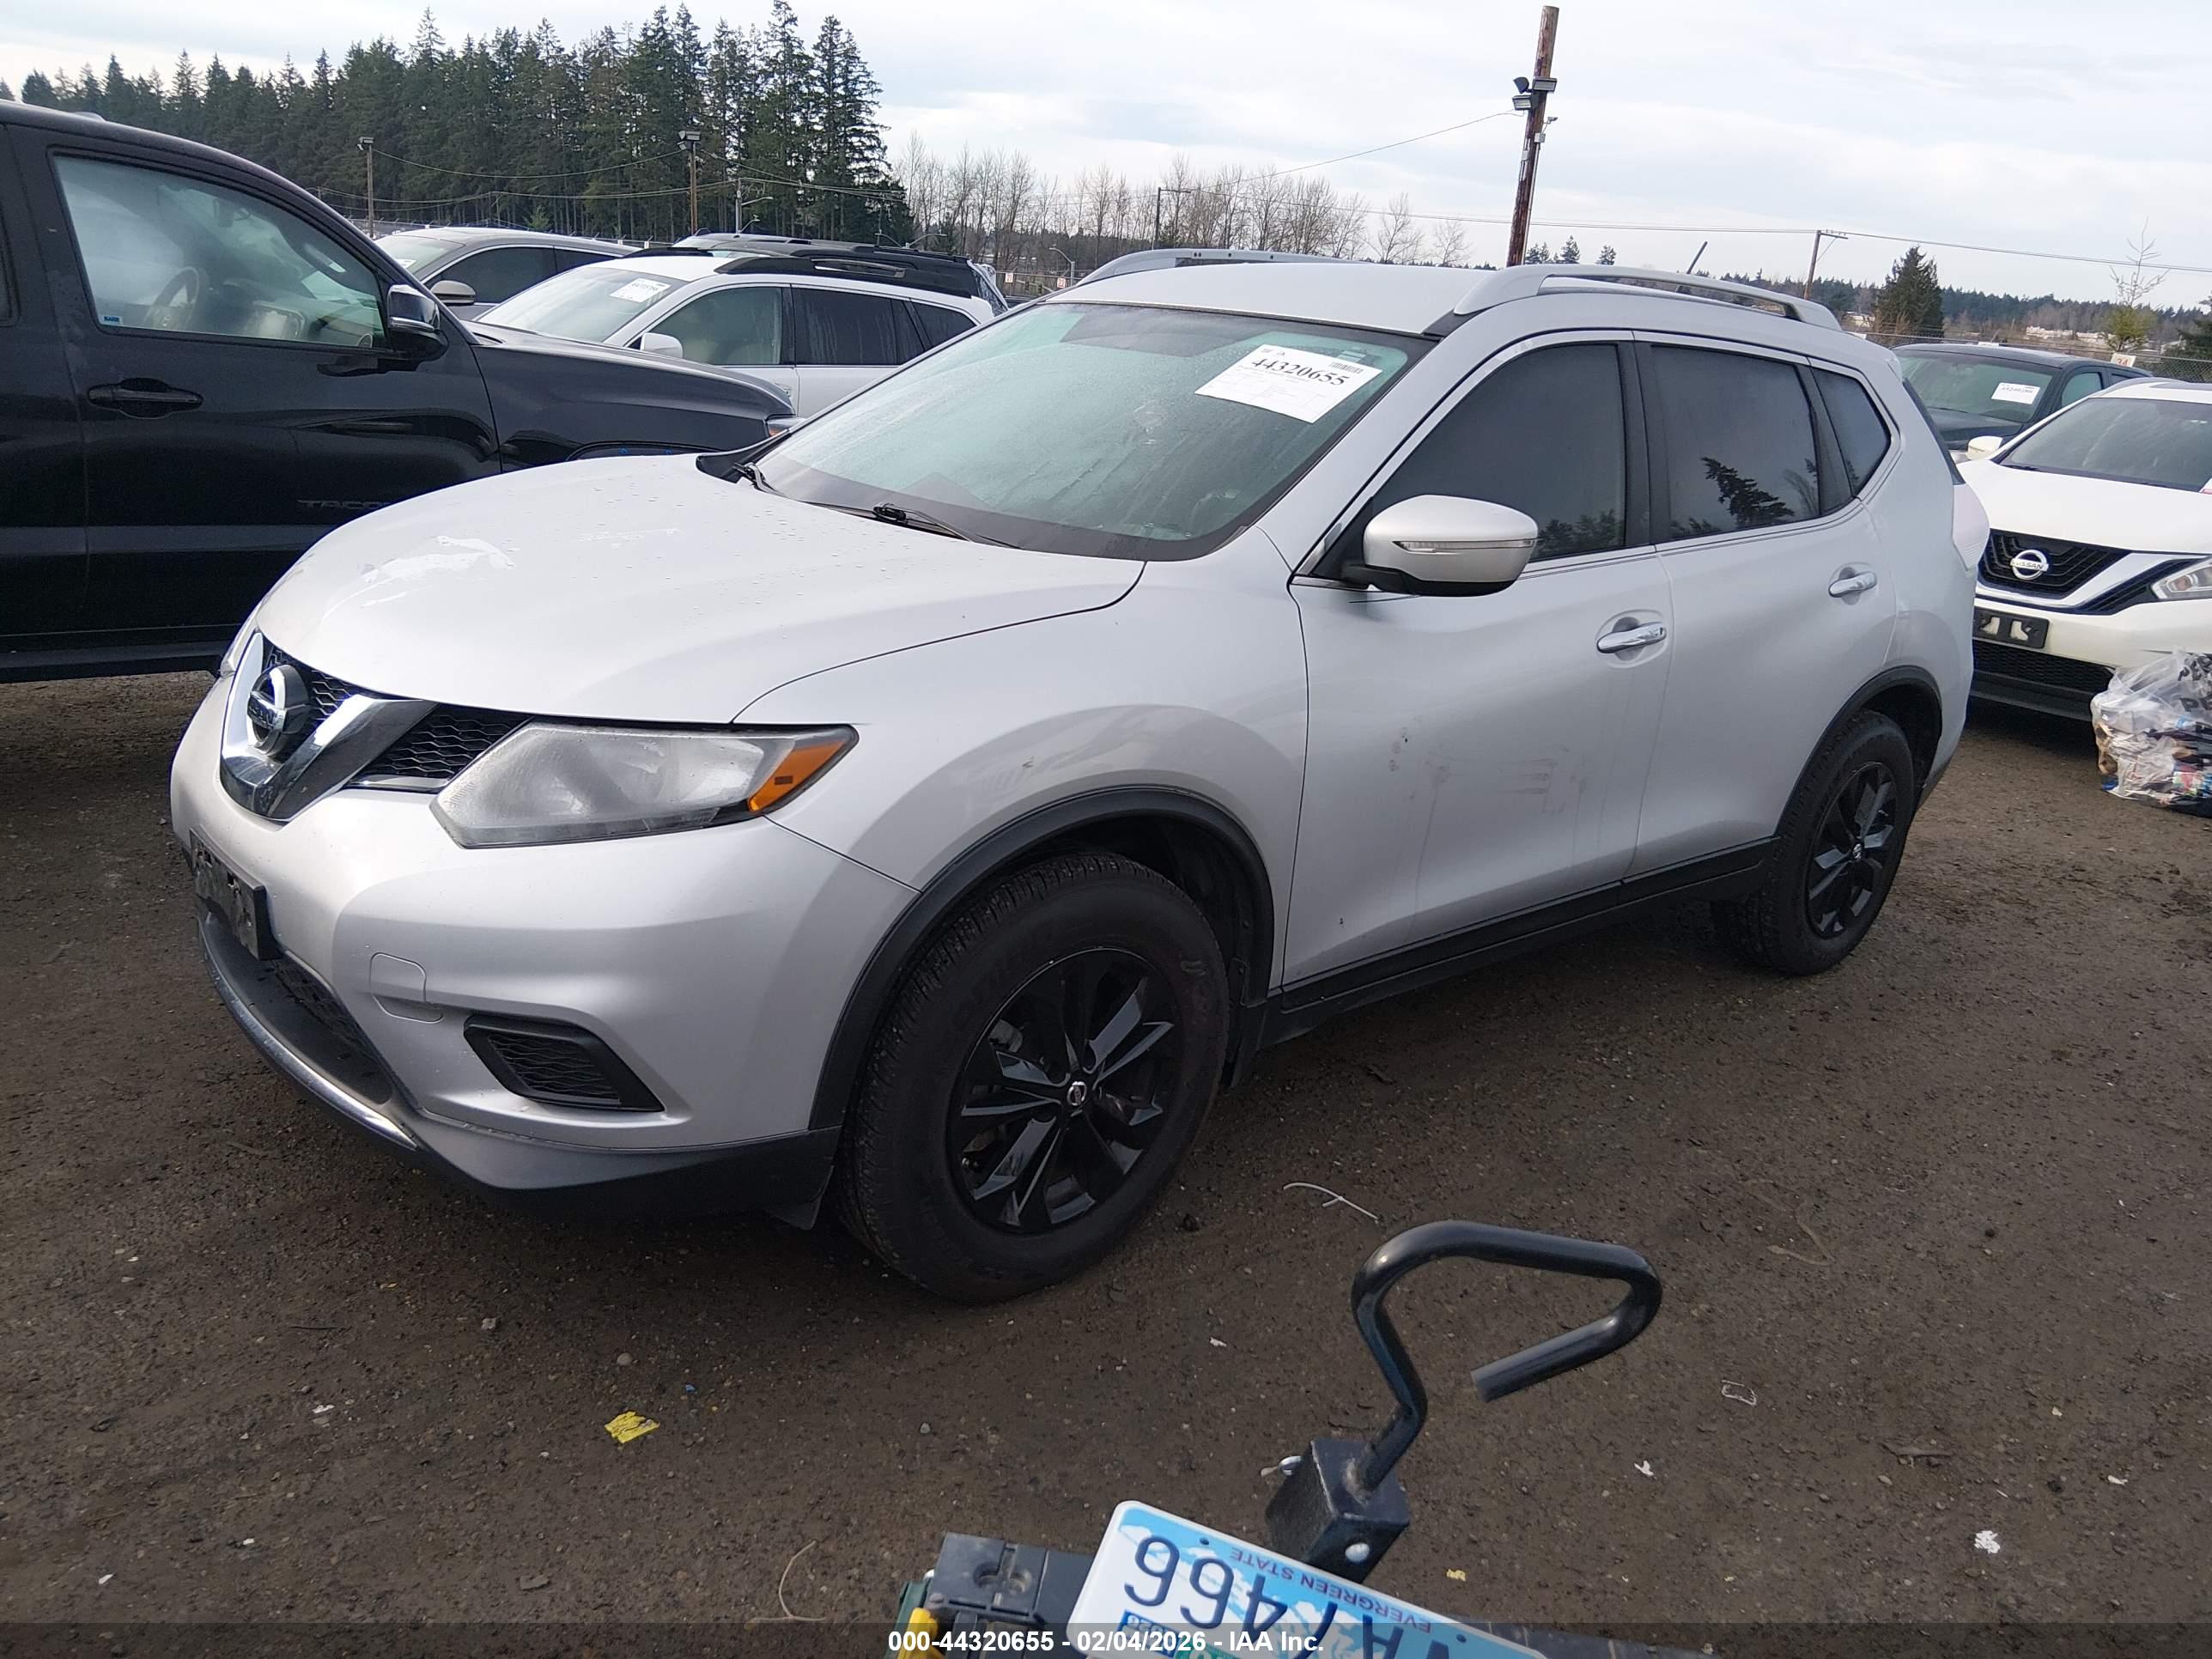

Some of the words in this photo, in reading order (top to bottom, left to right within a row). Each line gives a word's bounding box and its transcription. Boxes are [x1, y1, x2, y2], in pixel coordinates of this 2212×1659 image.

[1251, 358, 1350, 386] 44320655
[1229, 1547, 1294, 1580] STATE
[1124, 1535, 1449, 1659] A7466
[1300, 1574, 1432, 1634] EVERGREEN
